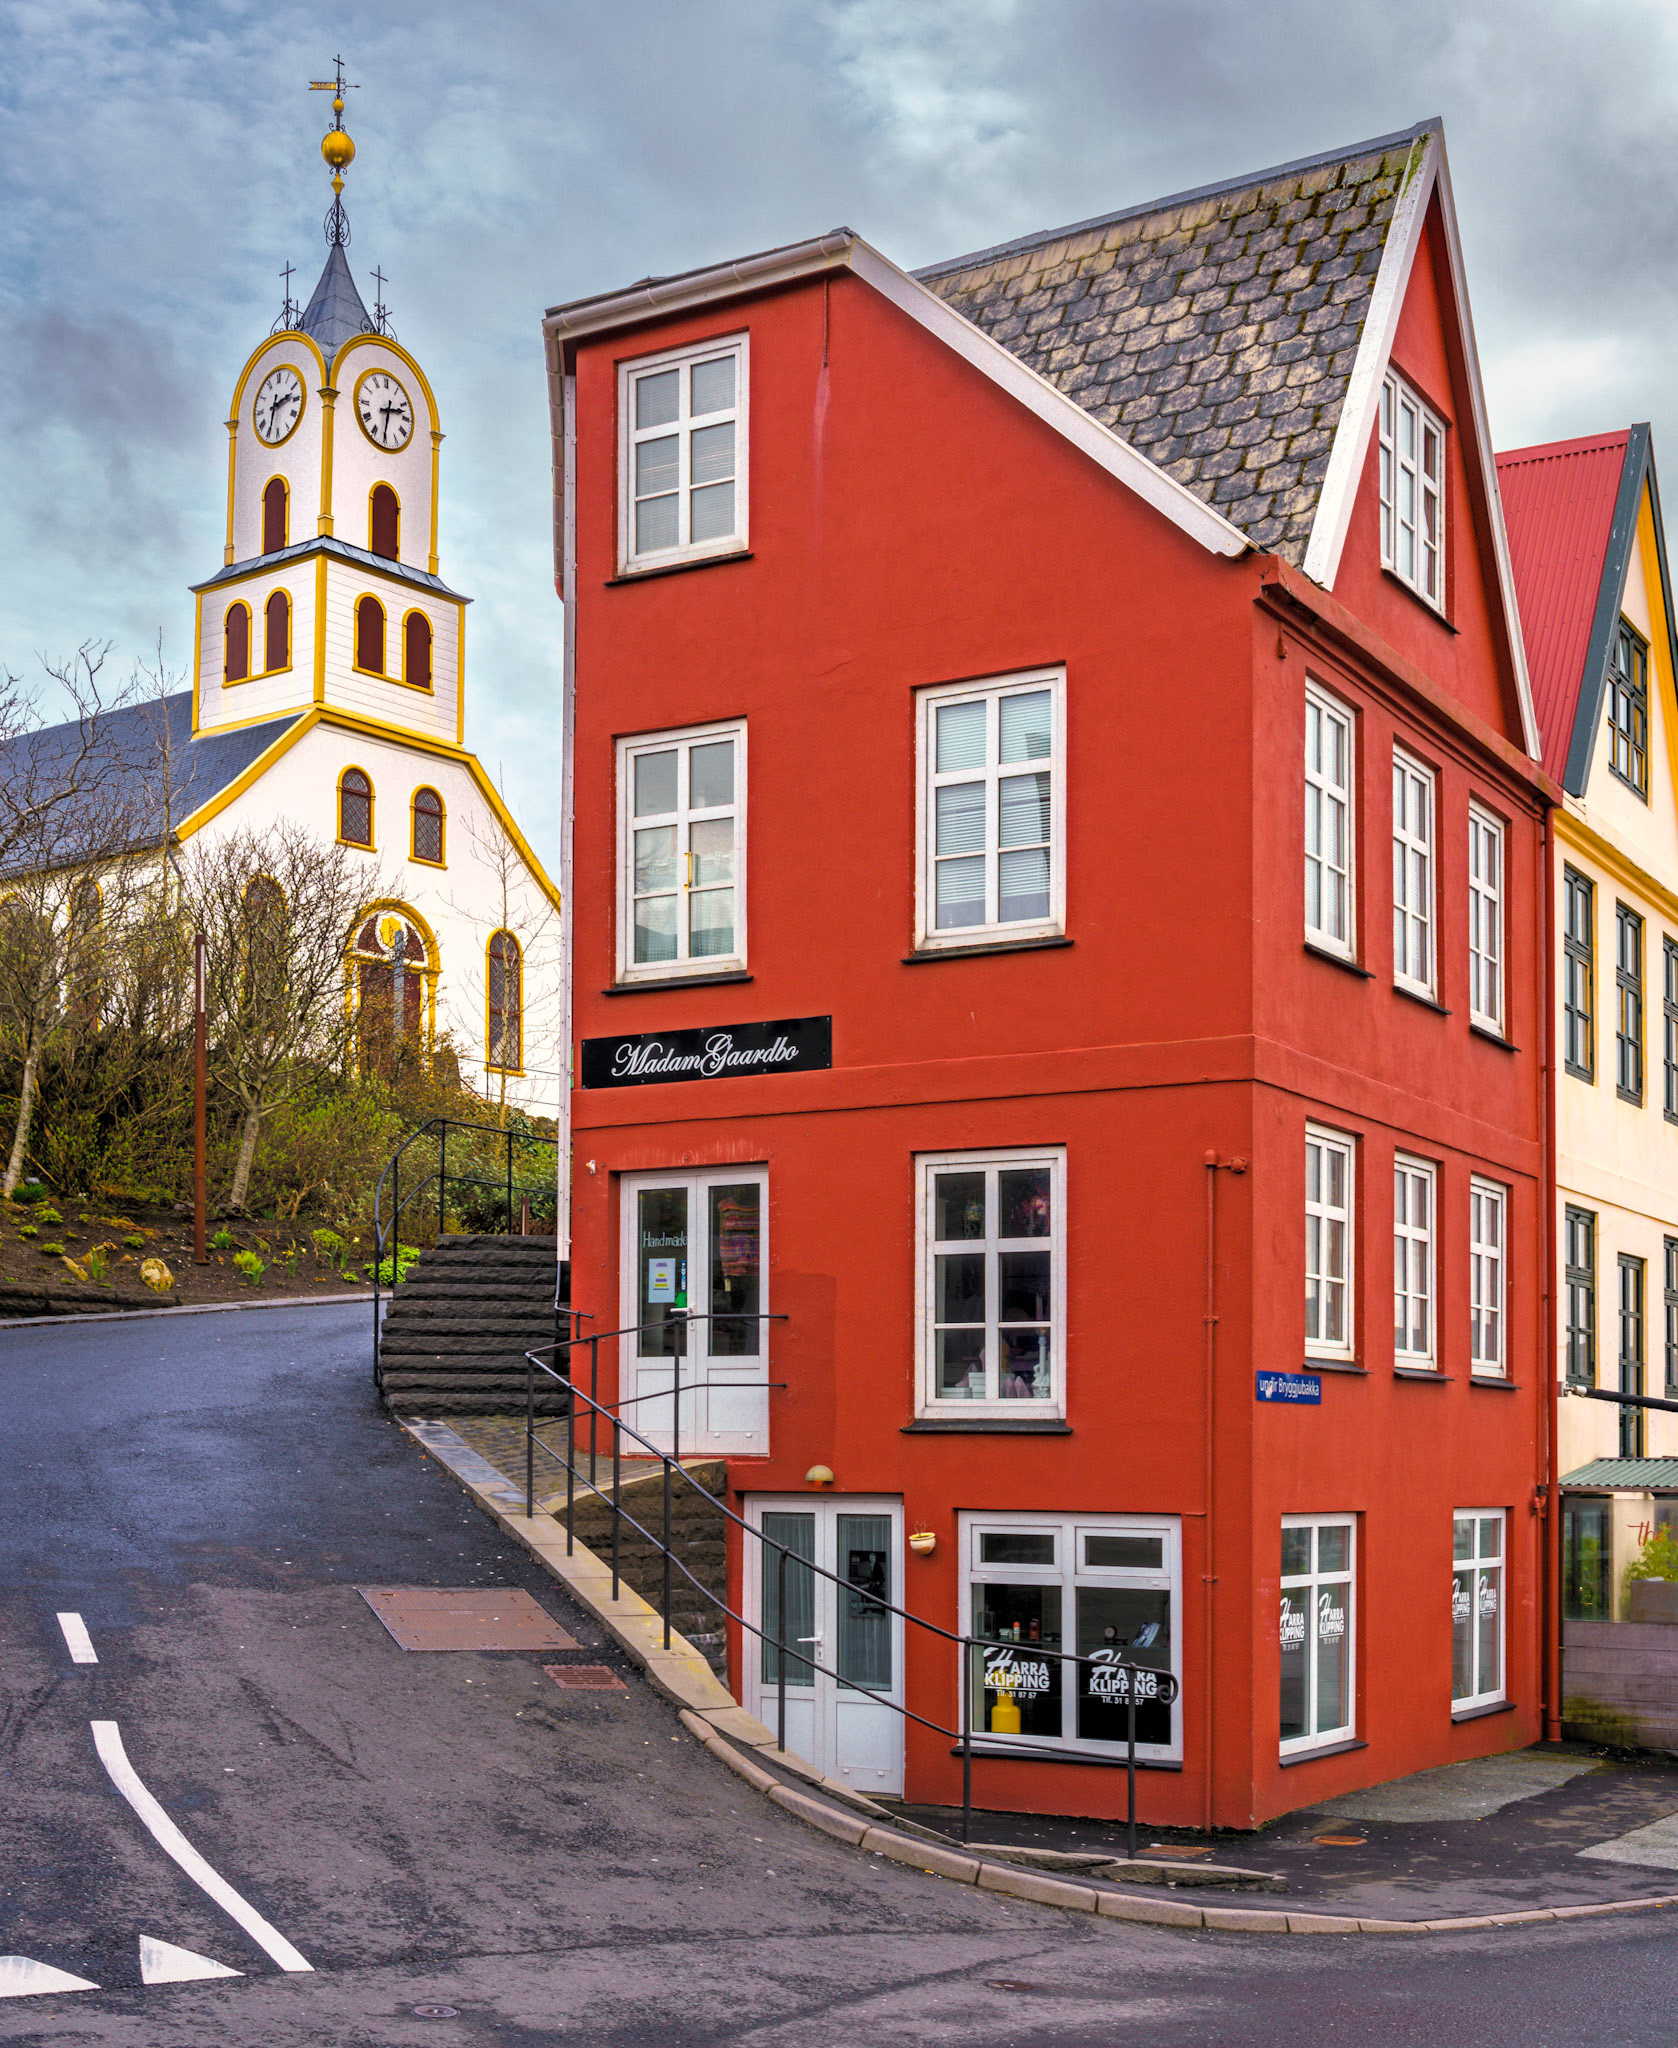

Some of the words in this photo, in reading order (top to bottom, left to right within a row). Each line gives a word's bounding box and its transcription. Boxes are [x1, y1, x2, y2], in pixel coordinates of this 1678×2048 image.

[611, 1042, 700, 1077] Madam
[700, 1033, 799, 1077] Gaardbo
[1278, 1378, 1319, 1398] Bryggjubakka
[1319, 1592, 1344, 1623] HARRA
[983, 1647, 1049, 1676] HARRA
[1088, 1648, 1157, 1682] HARA
[984, 1672, 1050, 1689] KLIPPING
[1089, 1678, 1158, 1695] KLIPPNG
[1135, 1698, 1144, 1706] 57
